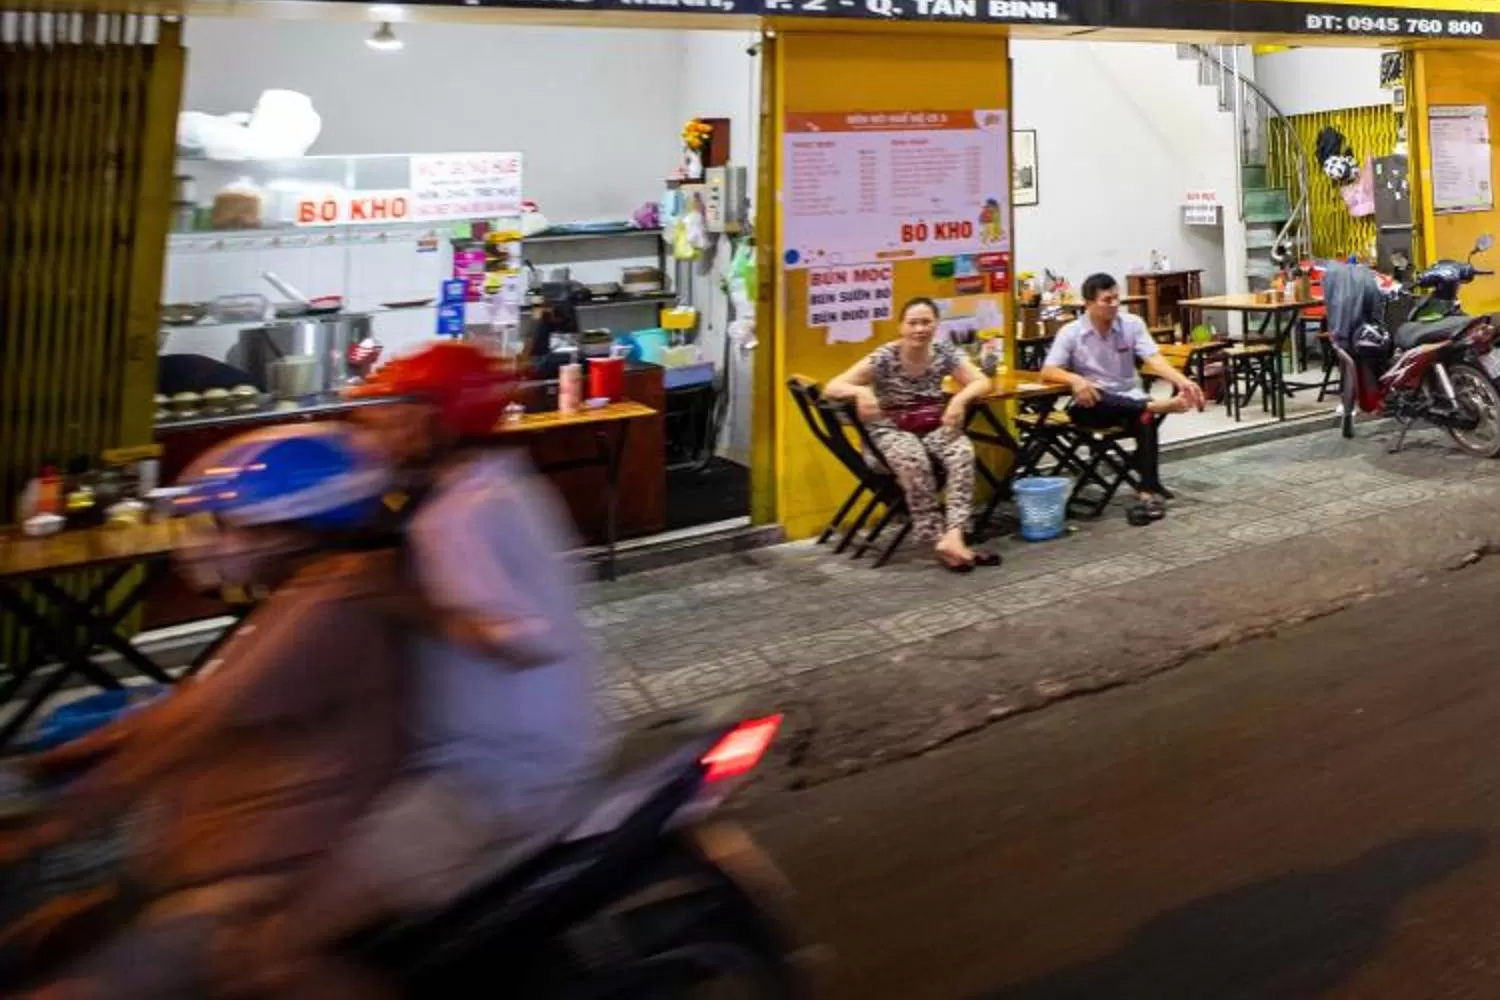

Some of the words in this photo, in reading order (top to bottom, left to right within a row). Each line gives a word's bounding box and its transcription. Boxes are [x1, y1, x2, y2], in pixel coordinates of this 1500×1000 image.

[1306, 13, 1342, 31] ĐT:
[1347, 15, 1399, 33] 0945
[1406, 18, 1442, 34] 760
[1448, 19, 1483, 36] 800
[350, 196, 407, 219] KHO
[901, 219, 929, 242] BÒ
[934, 220, 972, 241] KHO
